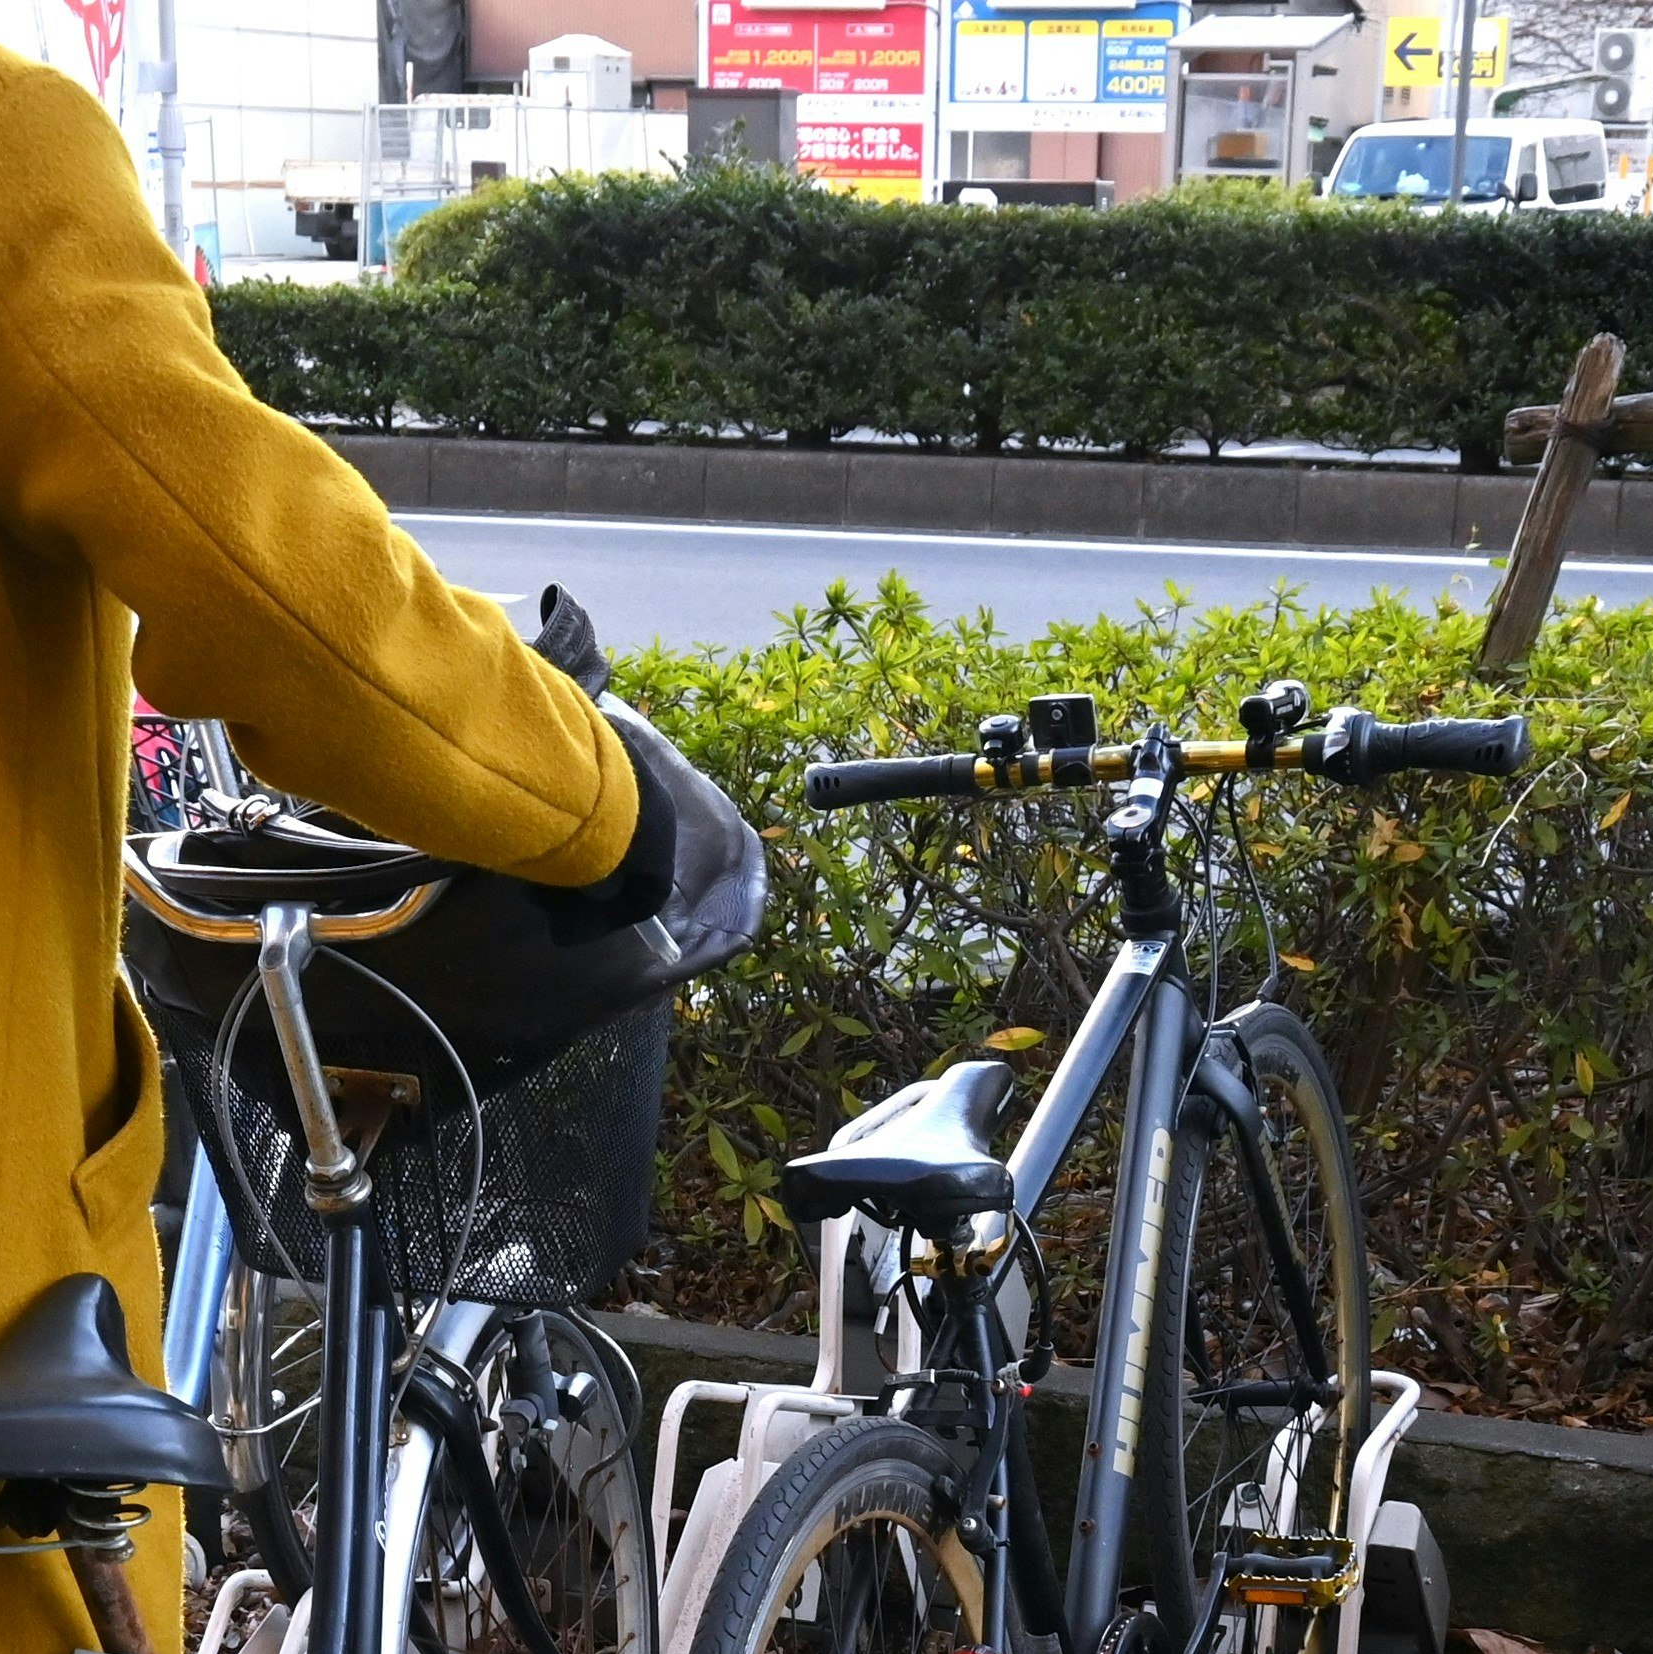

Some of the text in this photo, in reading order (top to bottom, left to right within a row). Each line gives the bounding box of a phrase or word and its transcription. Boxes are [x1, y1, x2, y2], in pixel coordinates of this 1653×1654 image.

[753, 49, 813, 66] 1,200円
[860, 50, 920, 67] 1,200円
[1106, 75, 1165, 95] 400円
